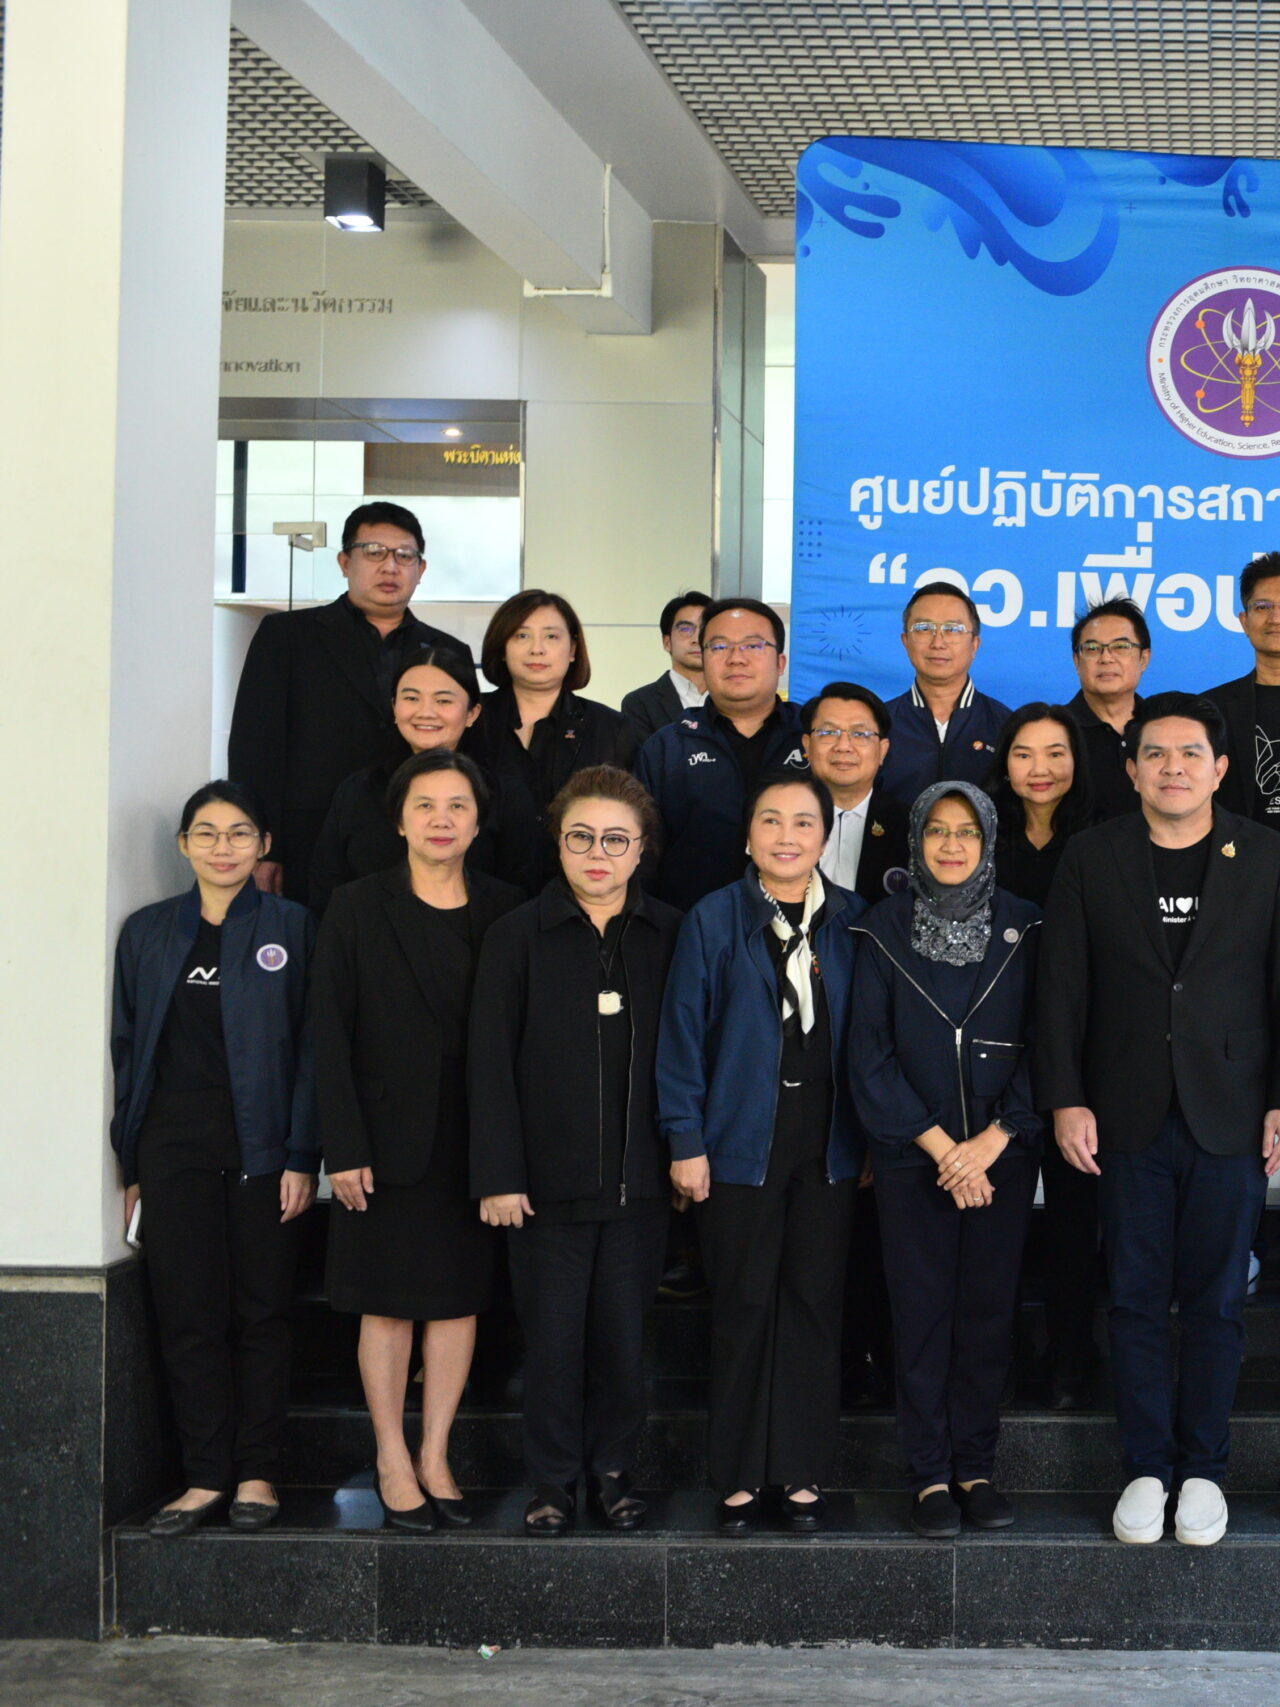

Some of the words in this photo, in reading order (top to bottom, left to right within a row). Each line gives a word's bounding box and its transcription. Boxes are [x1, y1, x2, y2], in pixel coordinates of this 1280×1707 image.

[1158, 372, 1172, 401] Ministry
[1170, 402, 1180, 410] of
[1176, 410, 1197, 430] Higher
